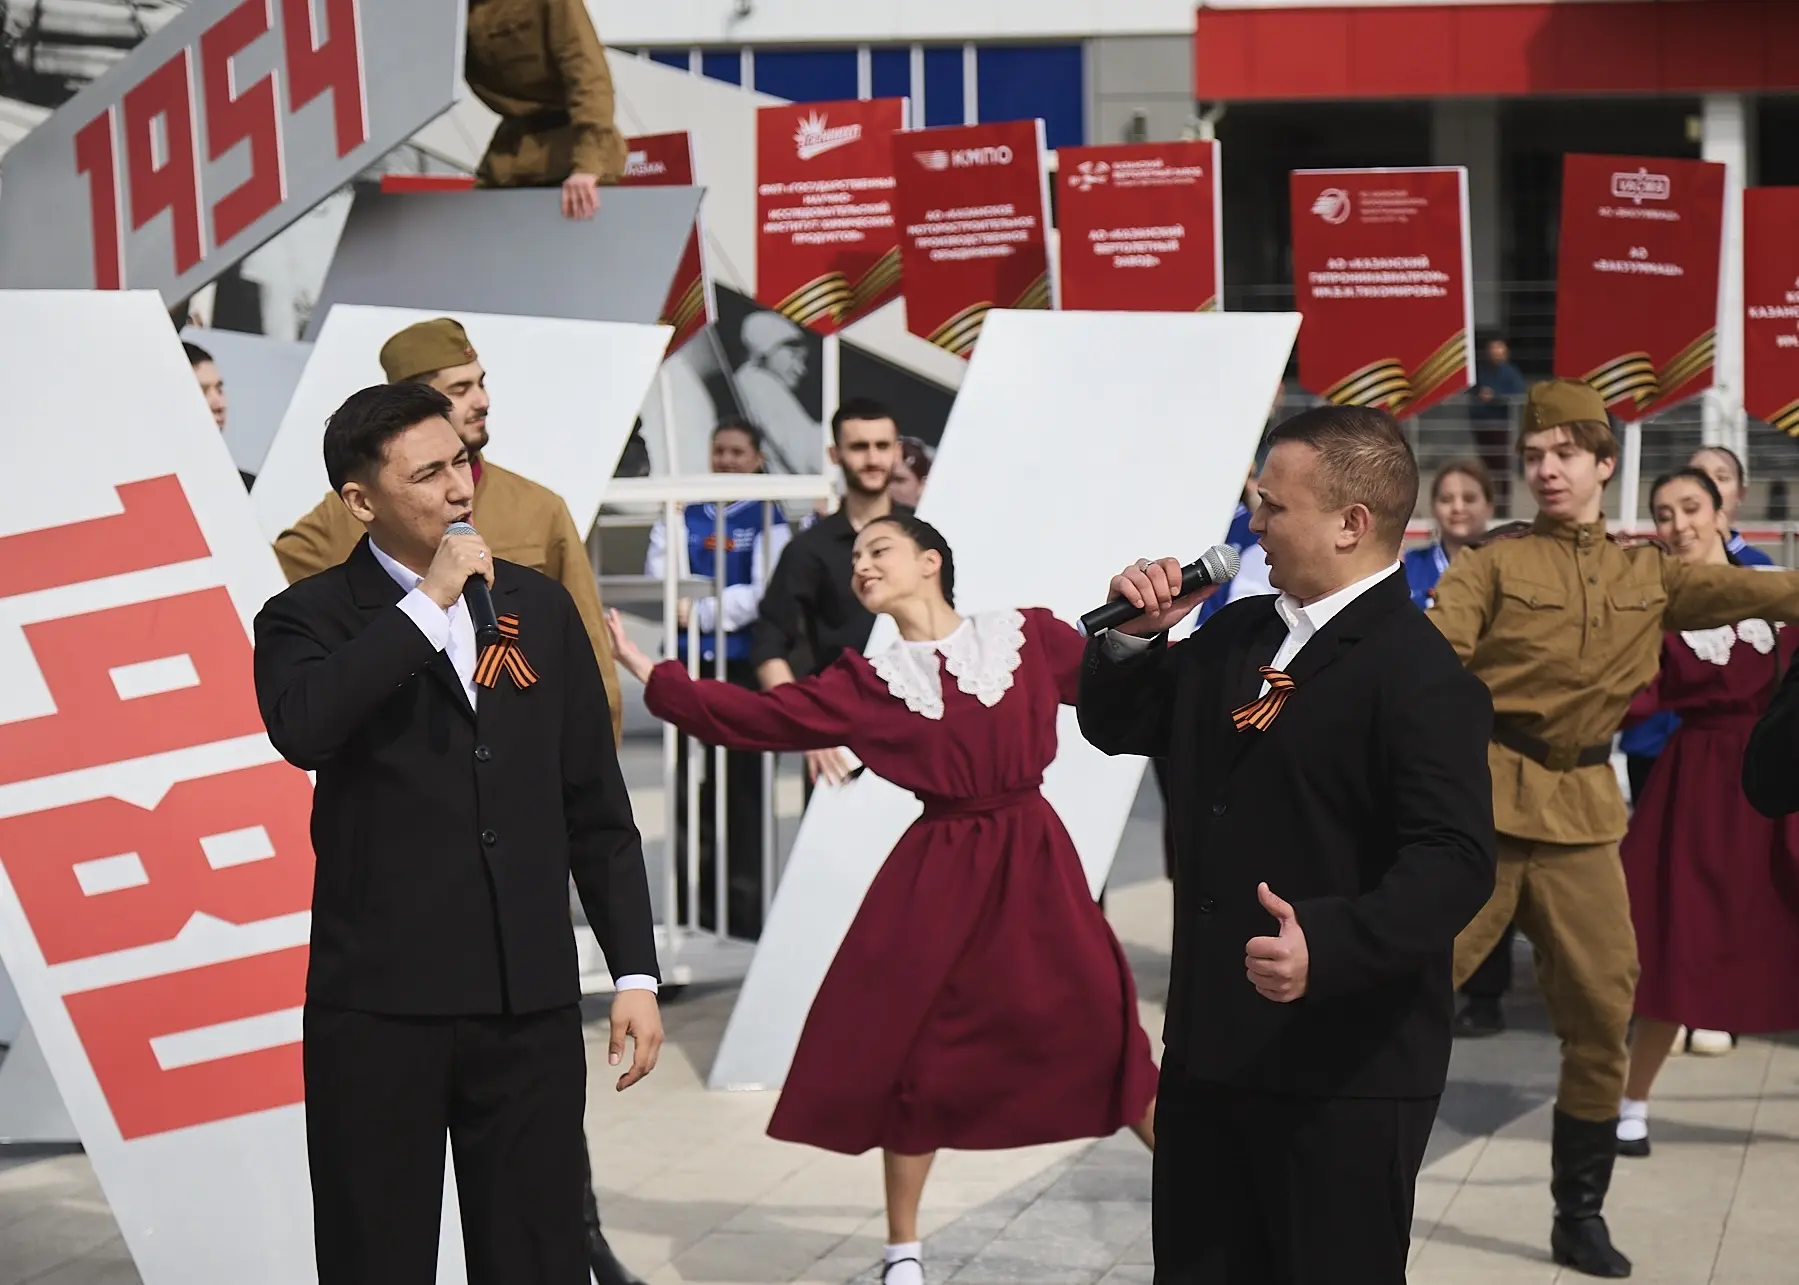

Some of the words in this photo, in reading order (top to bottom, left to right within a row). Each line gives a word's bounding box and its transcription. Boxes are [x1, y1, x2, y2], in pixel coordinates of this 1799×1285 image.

[73, 0, 370, 290] 1954
[951, 145, 1013, 167] КМПО
[1629, 247, 1648, 259] АО
[1326, 257, 1347, 270] АО
